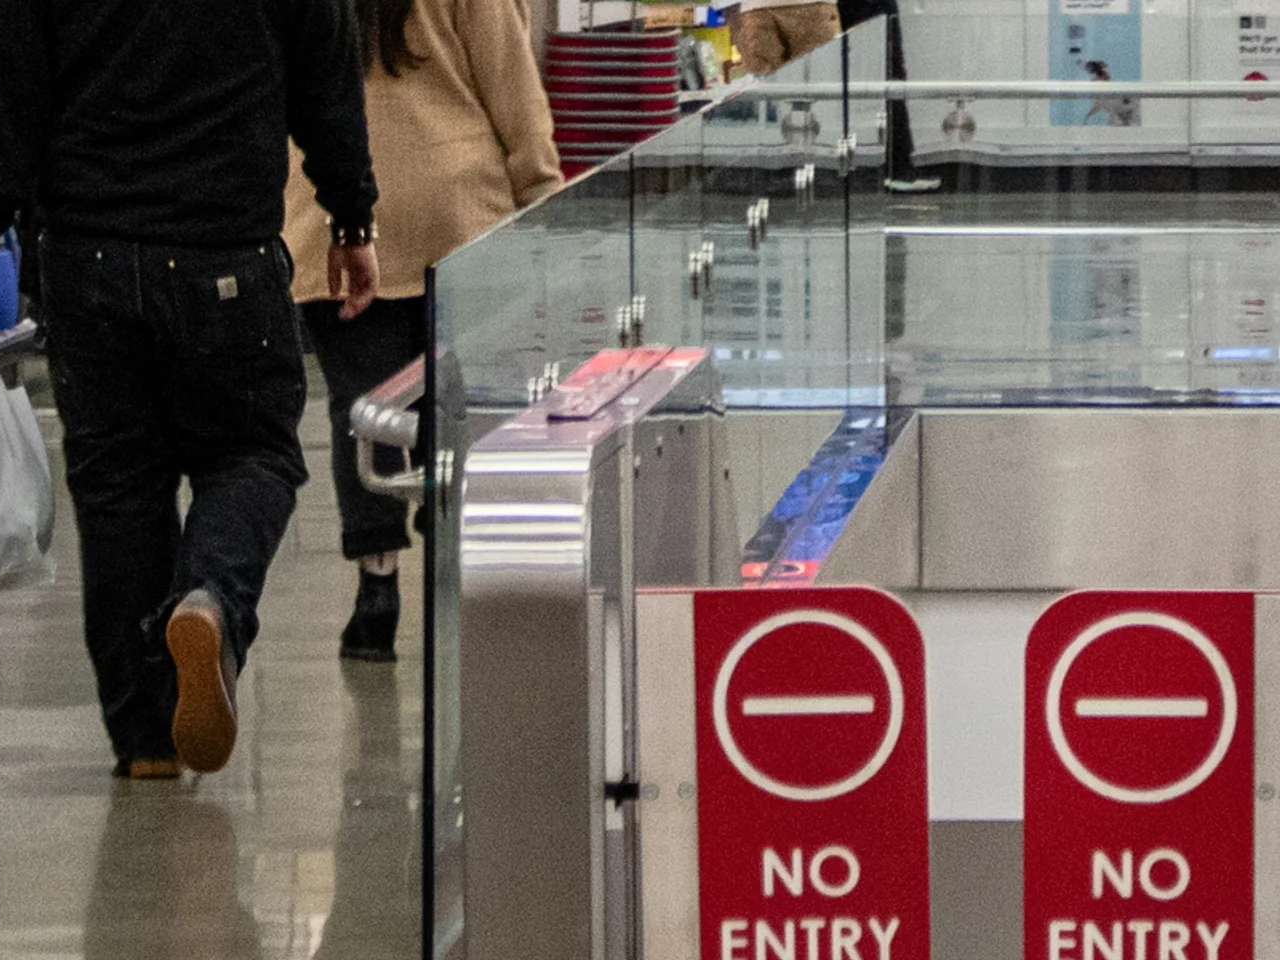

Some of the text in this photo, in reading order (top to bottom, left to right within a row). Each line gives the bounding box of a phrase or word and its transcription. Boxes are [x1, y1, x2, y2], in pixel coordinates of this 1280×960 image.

[763, 845, 860, 898] NO
[1092, 847, 1191, 901] NO
[721, 916, 900, 960] ENTRY
[1048, 919, 1230, 960] ENTRY
